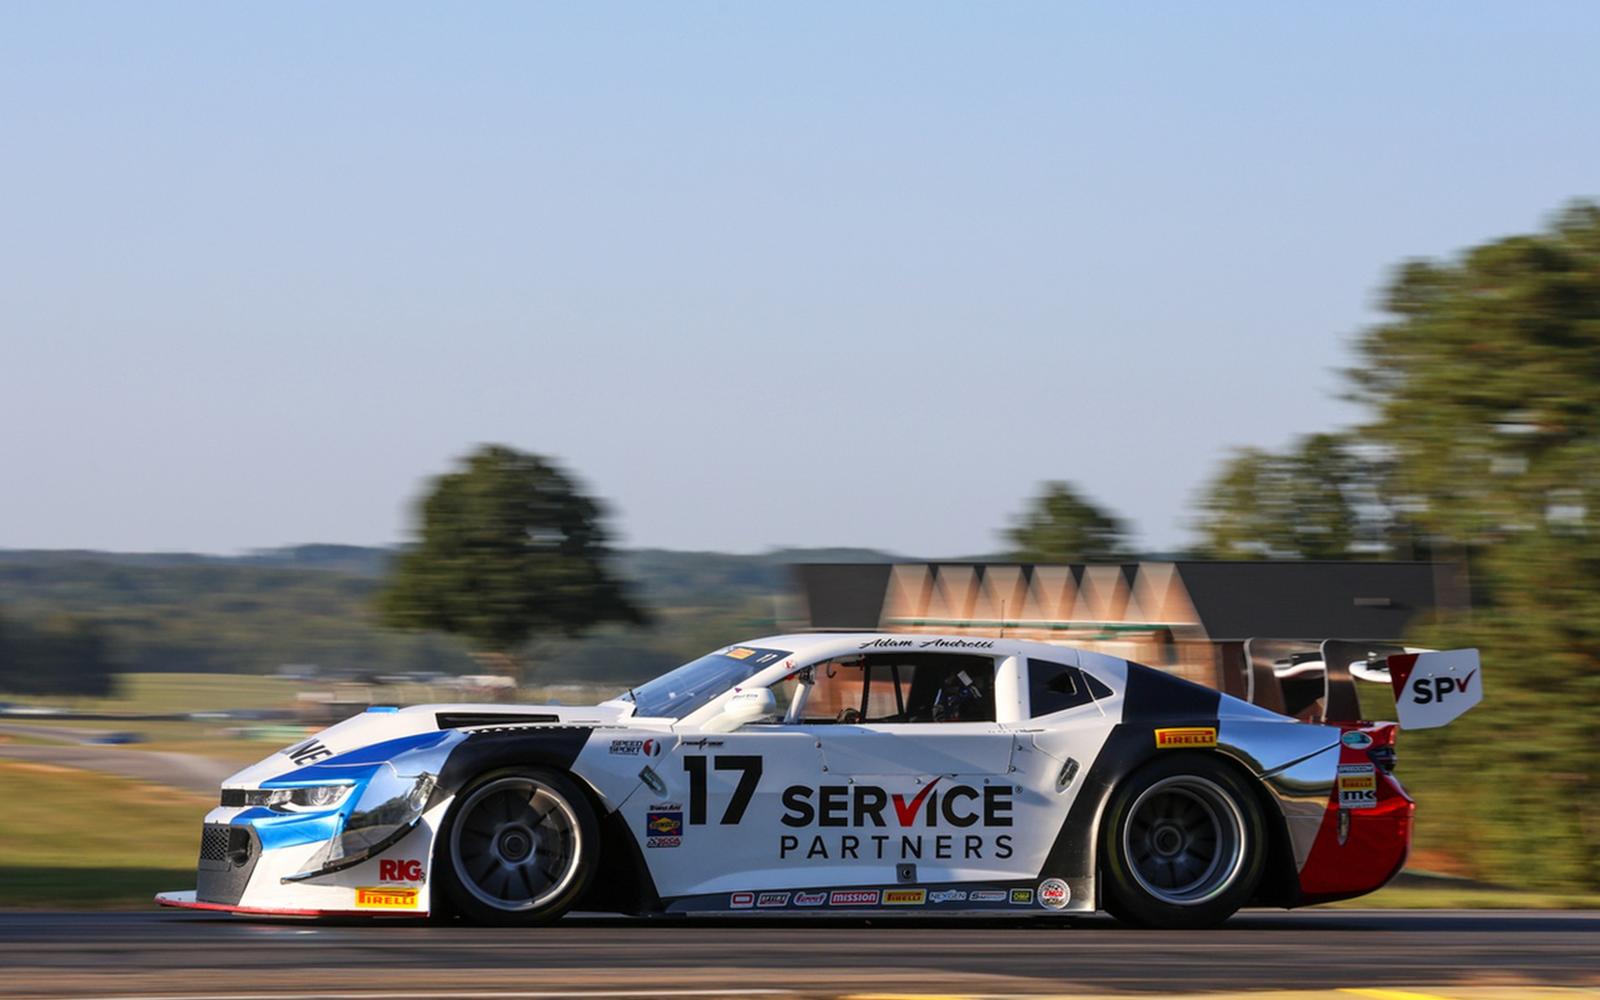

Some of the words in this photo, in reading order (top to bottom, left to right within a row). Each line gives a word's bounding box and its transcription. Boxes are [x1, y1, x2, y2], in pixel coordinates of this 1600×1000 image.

[860, 638, 912, 649] Adam
[1160, 730, 1214, 745] PIRELLI
[683, 755, 763, 825] 17
[780, 775, 1014, 828] SERVICE
[780, 835, 1014, 860] PARTNERS
[379, 860, 421, 881] RIG
[358, 889, 415, 905] PIRELLI
